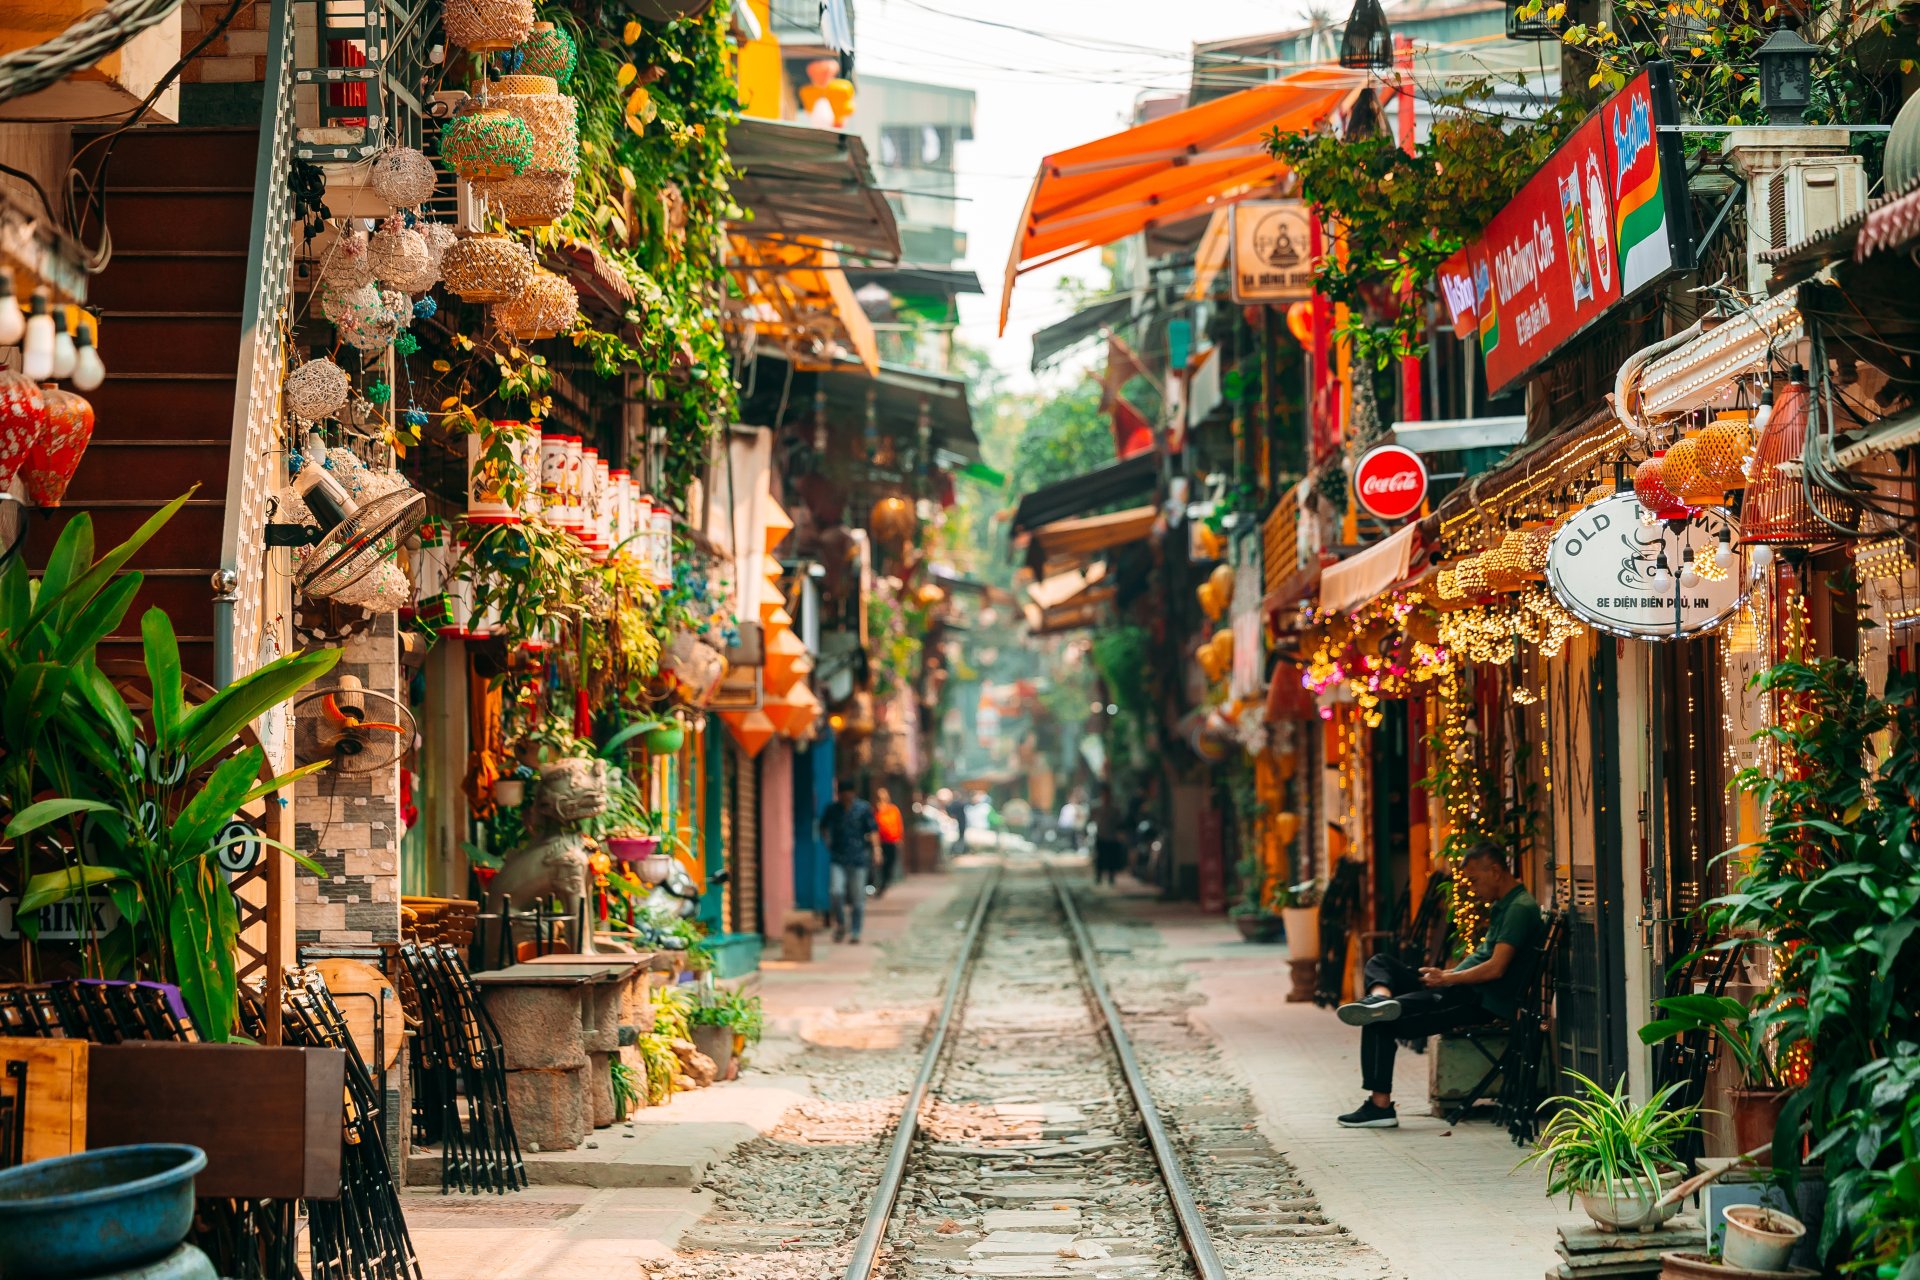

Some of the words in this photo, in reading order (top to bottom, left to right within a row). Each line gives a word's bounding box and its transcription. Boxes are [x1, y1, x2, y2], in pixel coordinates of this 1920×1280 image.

[1565, 513, 1611, 557] OLD
[1596, 597, 1610, 608] 8E
[1640, 595, 1664, 608] BIÊN
[1693, 598, 1709, 609] HN
